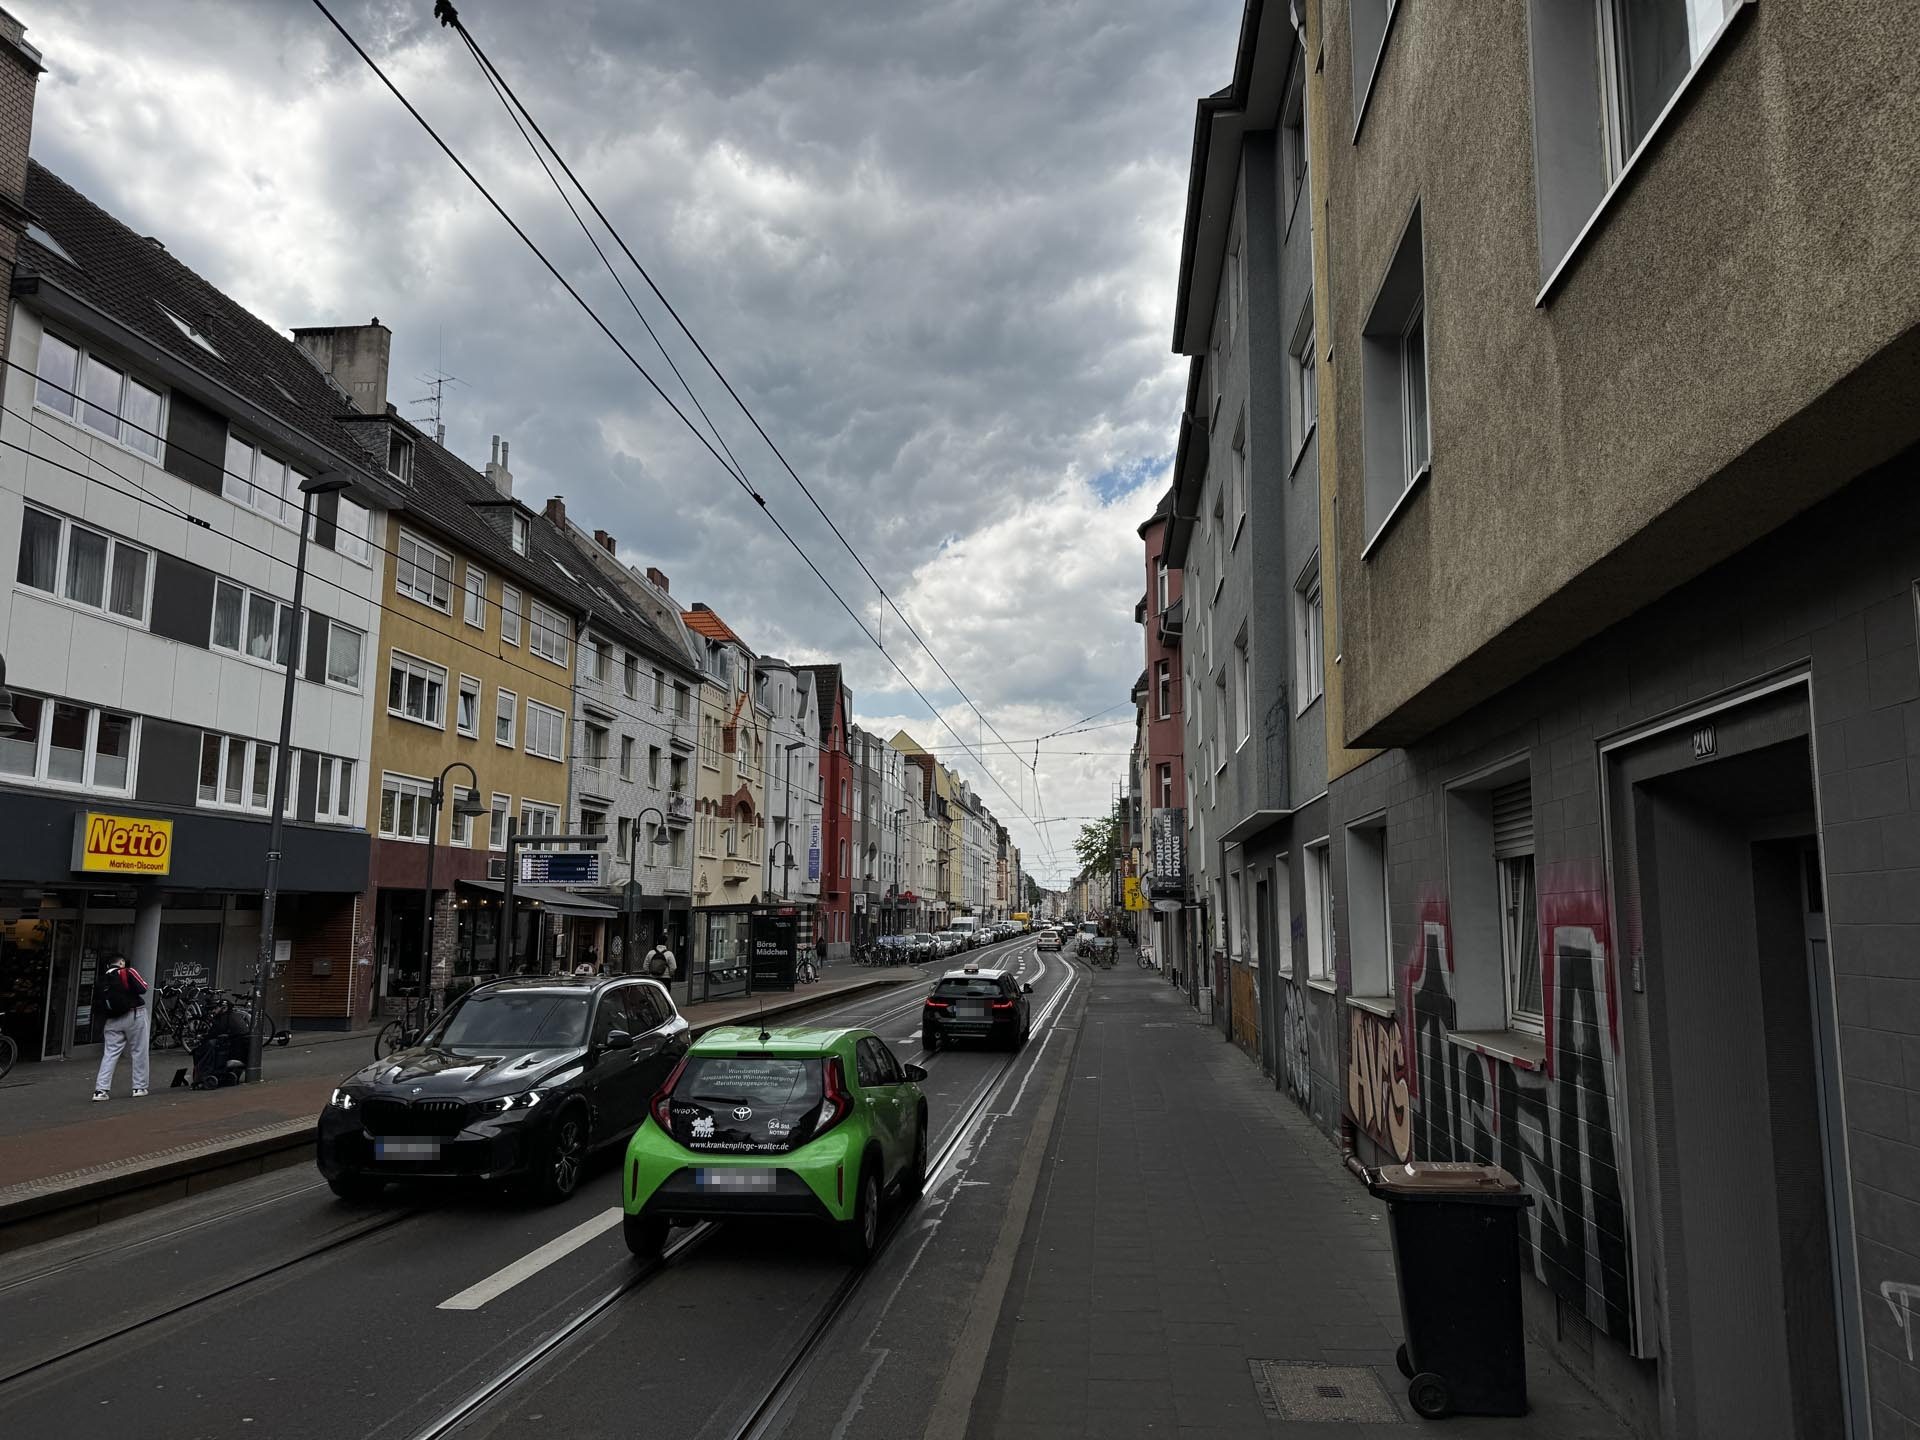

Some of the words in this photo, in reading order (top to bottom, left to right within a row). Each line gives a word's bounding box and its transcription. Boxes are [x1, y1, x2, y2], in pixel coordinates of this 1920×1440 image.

[1694, 728, 1713, 755] 210
[88, 818, 167, 857] Netto
[810, 825, 820, 848] Kemp
[1164, 814, 1172, 877] AKADEMIE
[109, 860, 164, 871] Marken-Discount
[1156, 838, 1164, 877] SPORT
[1172, 835, 1181, 877] PRANG
[756, 940, 777, 948] Börse
[756, 948, 788, 956] Mädchen
[173, 962, 202, 977] Netto
[689, 1140, 790, 1151] www.krankenpflege-walter.de
